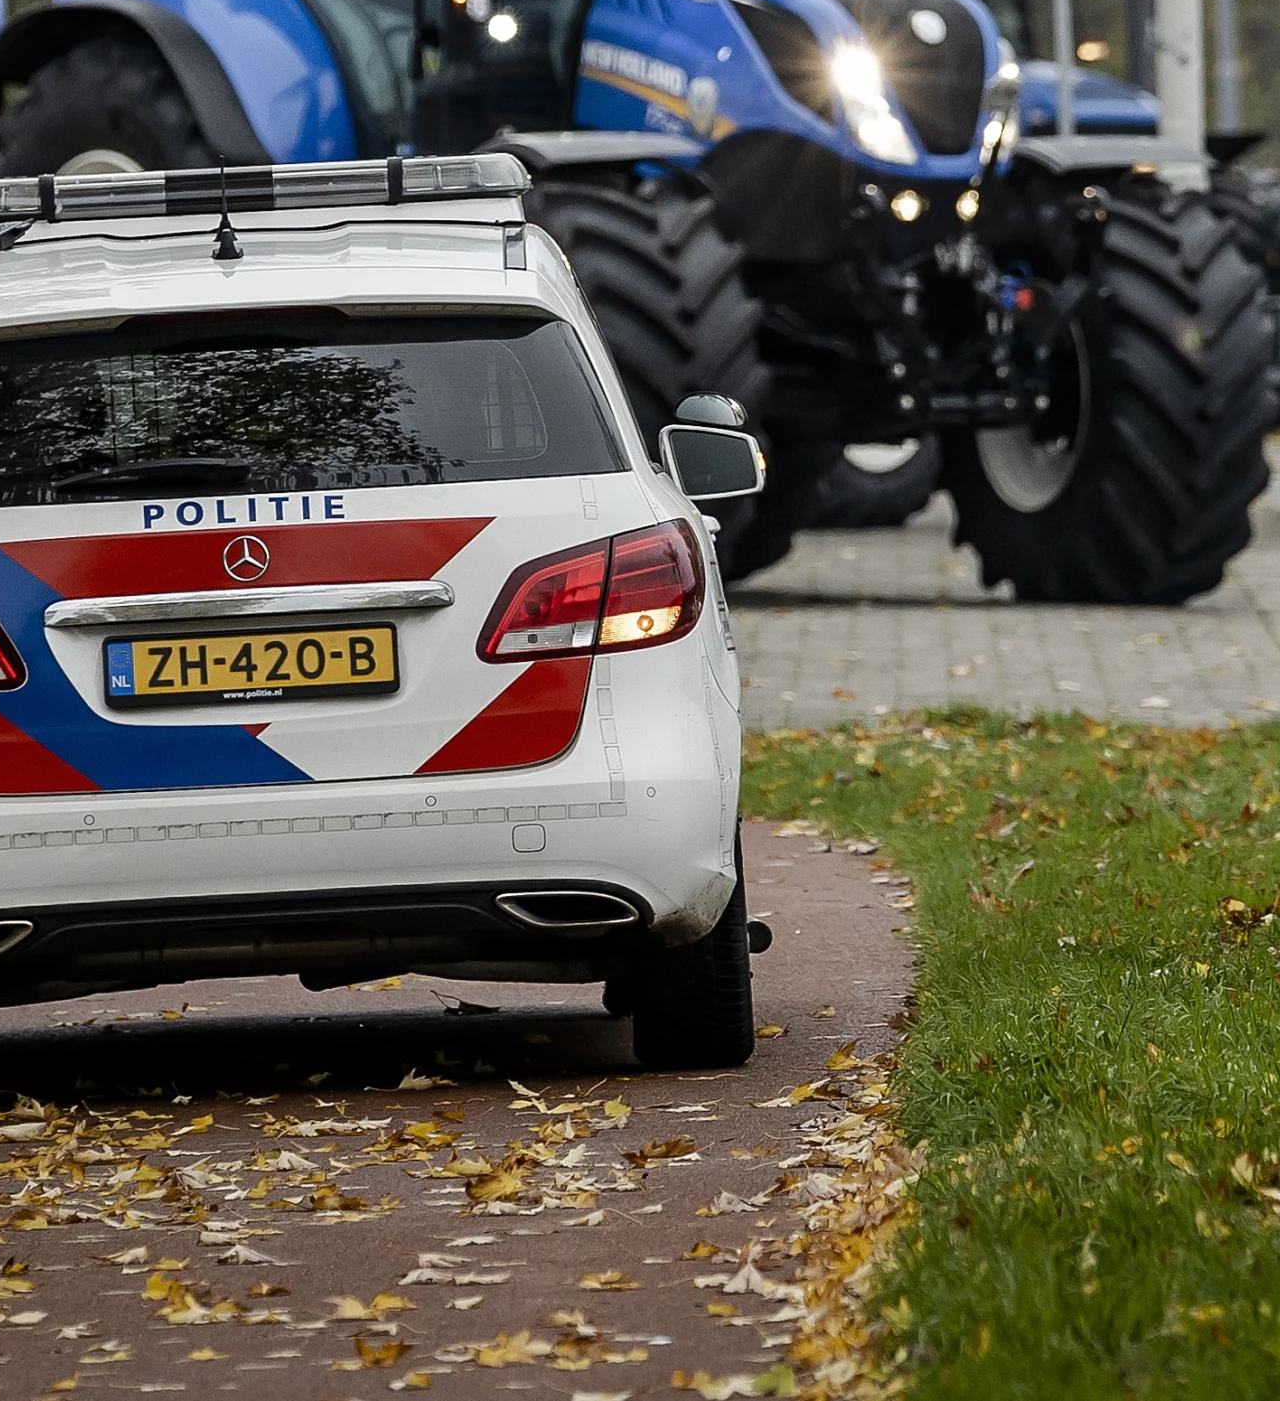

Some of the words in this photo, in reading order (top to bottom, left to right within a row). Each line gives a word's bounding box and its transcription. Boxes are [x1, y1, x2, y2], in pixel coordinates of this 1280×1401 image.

[143, 495, 345, 529] POLITIE
[147, 636, 376, 688] ZH-420-B
[111, 675, 131, 688] NL
[223, 687, 283, 699] www.politie.nl
